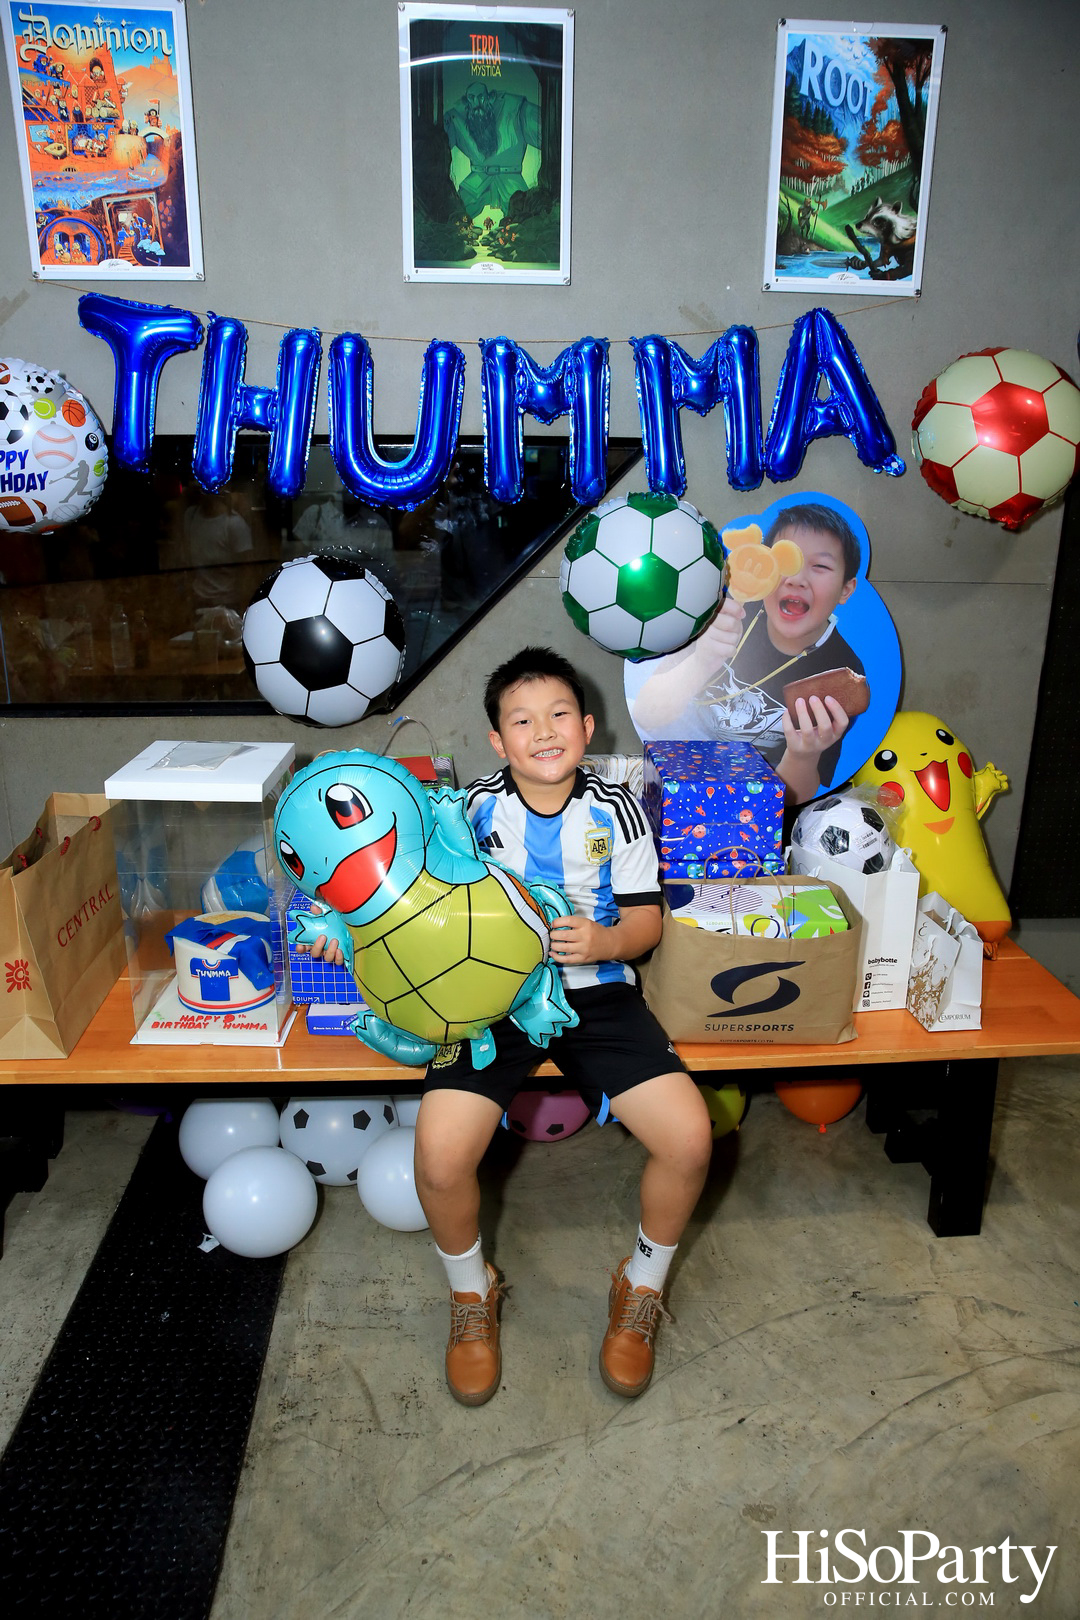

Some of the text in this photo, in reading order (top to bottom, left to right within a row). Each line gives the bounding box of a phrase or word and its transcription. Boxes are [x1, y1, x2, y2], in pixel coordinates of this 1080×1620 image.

[18, 4, 173, 62] Dominion
[469, 34, 502, 65] TERRA
[471, 63, 502, 77] MYSTICA
[799, 38, 875, 121] ROOT
[78, 292, 907, 512] THUMMA
[592, 838, 607, 854] AFA
[57, 884, 114, 948] CENTRAL
[867, 957, 898, 965] babybotte
[151, 1021, 268, 1030] BIRTHDAY HUMMA
[704, 1023, 795, 1032] SUPERSPORTS
